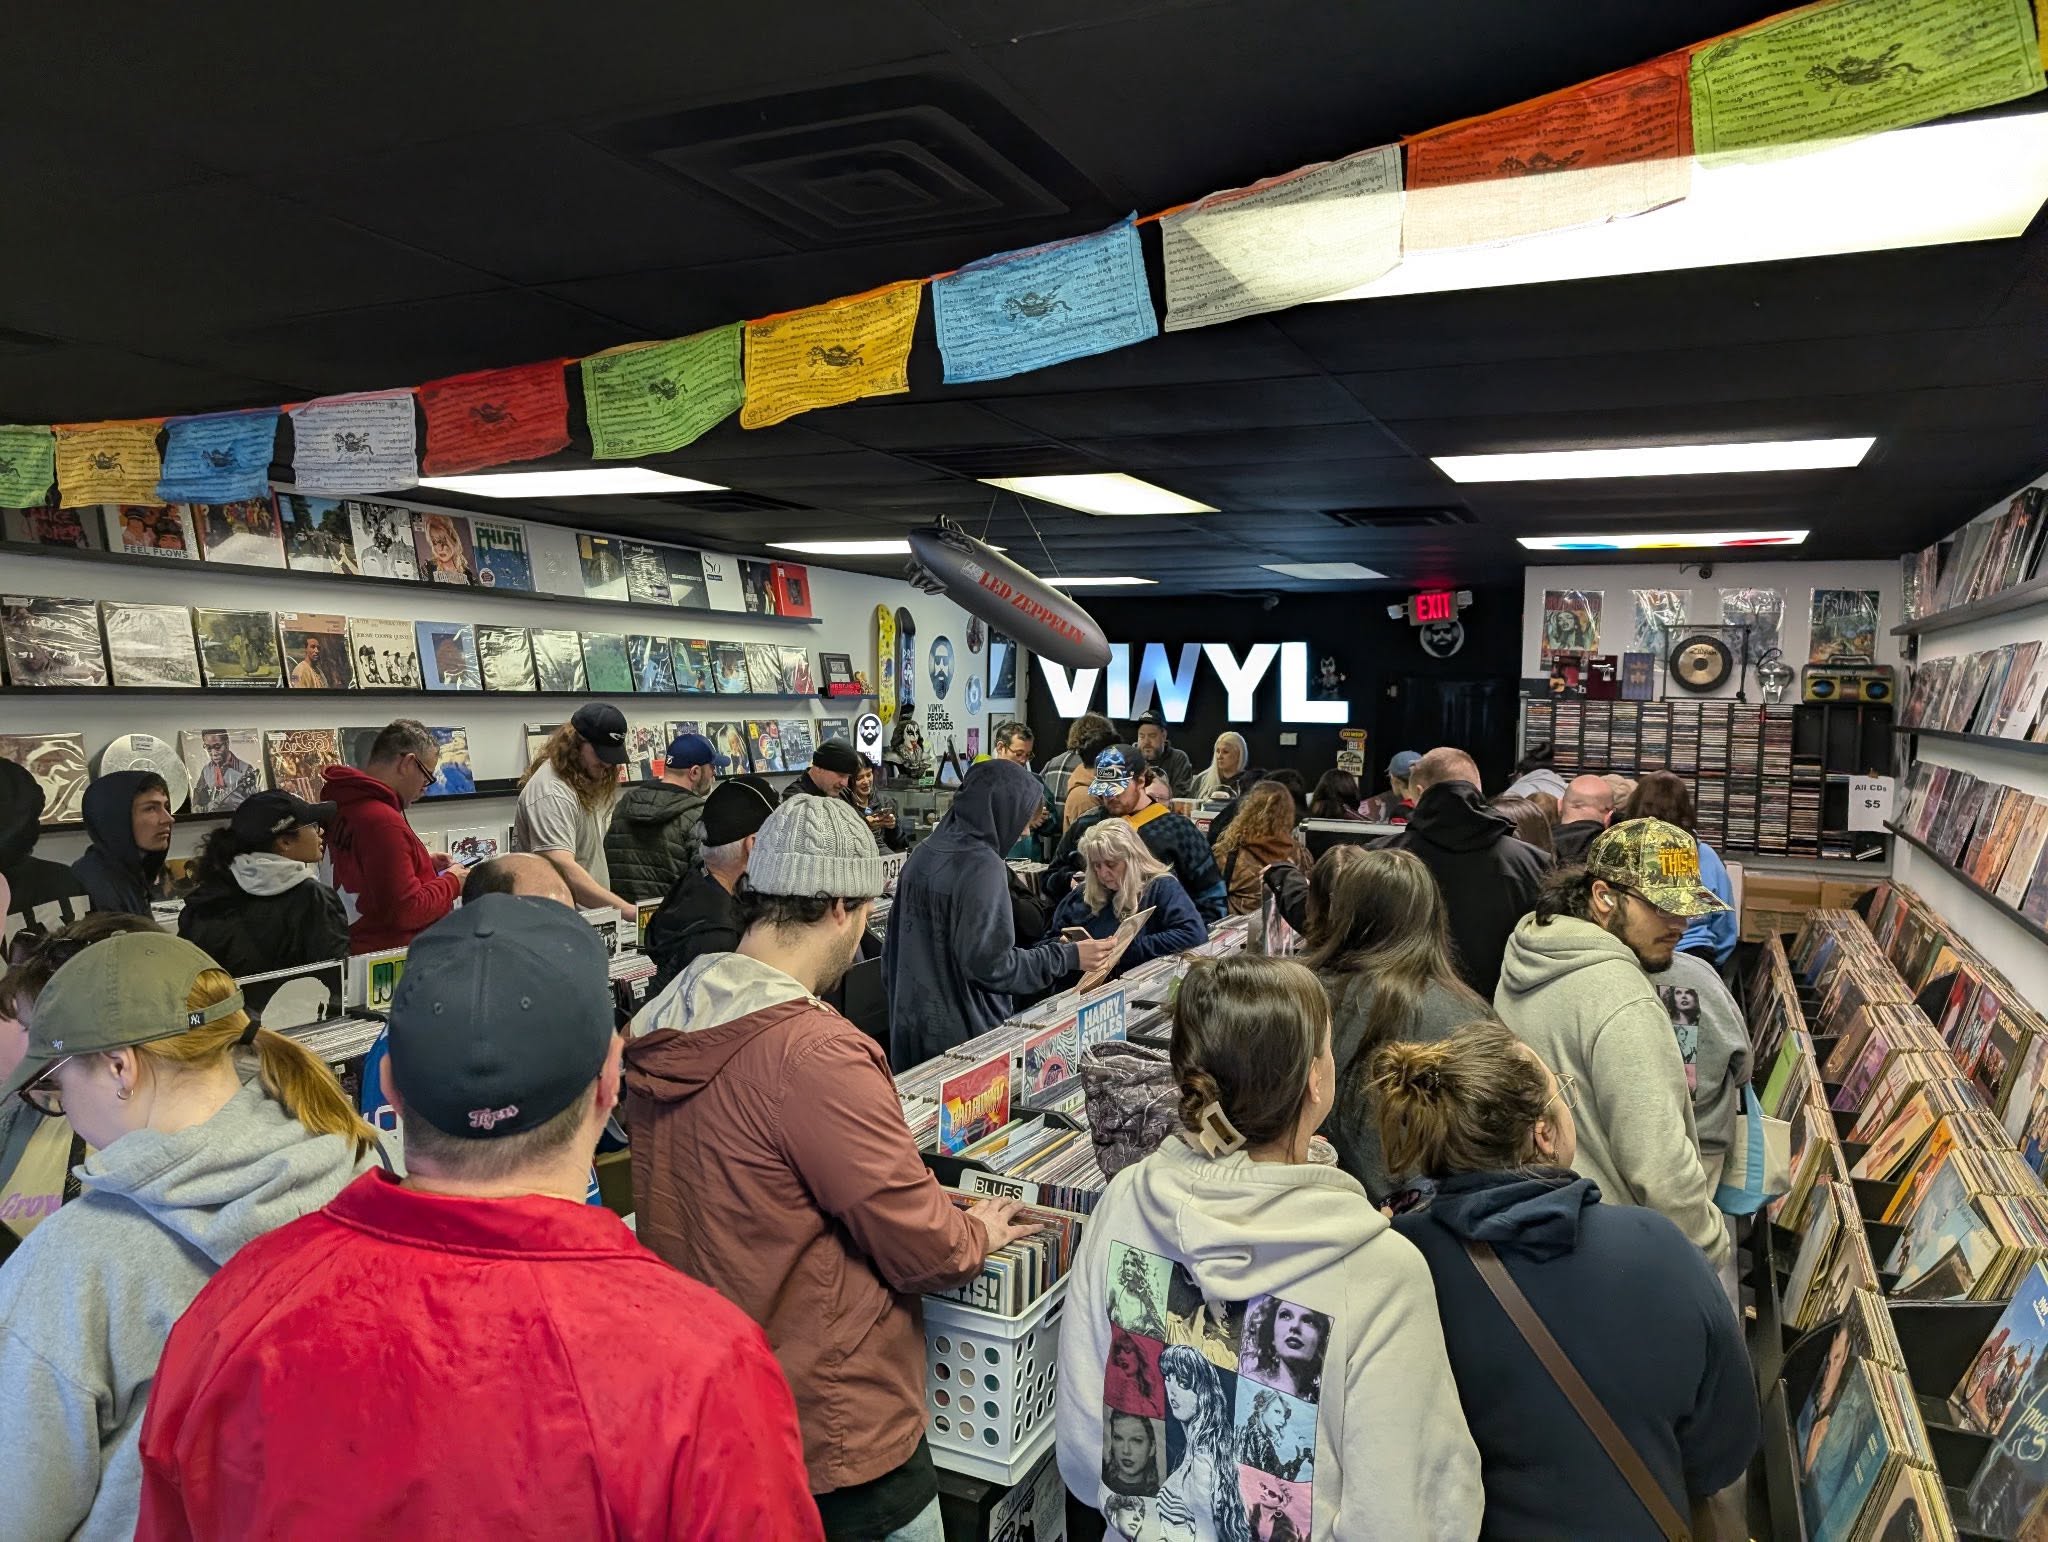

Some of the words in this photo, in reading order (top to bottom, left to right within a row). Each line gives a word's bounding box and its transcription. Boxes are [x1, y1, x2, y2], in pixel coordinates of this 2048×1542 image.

[124, 544, 149, 555] FEEL
[153, 546, 188, 558] FLOWS
[704, 554, 721, 574] So
[978, 570, 1012, 600] LED
[1011, 591, 1085, 646] ZEPPELIN
[1416, 593, 1451, 620] EXIT
[1037, 642, 1348, 723] VINYL
[927, 703, 944, 712] VINYL
[927, 713, 949, 721] PEOPLE
[927, 721, 953, 730] RECORDS
[1869, 784, 1887, 792] CDs
[1864, 799, 1881, 809] $5
[1084, 995, 1120, 1029] HARRY
[1081, 1014, 1122, 1046] STYLES
[467, 1104, 520, 1130] Tigers
[974, 1179, 1023, 1201] BLUES
